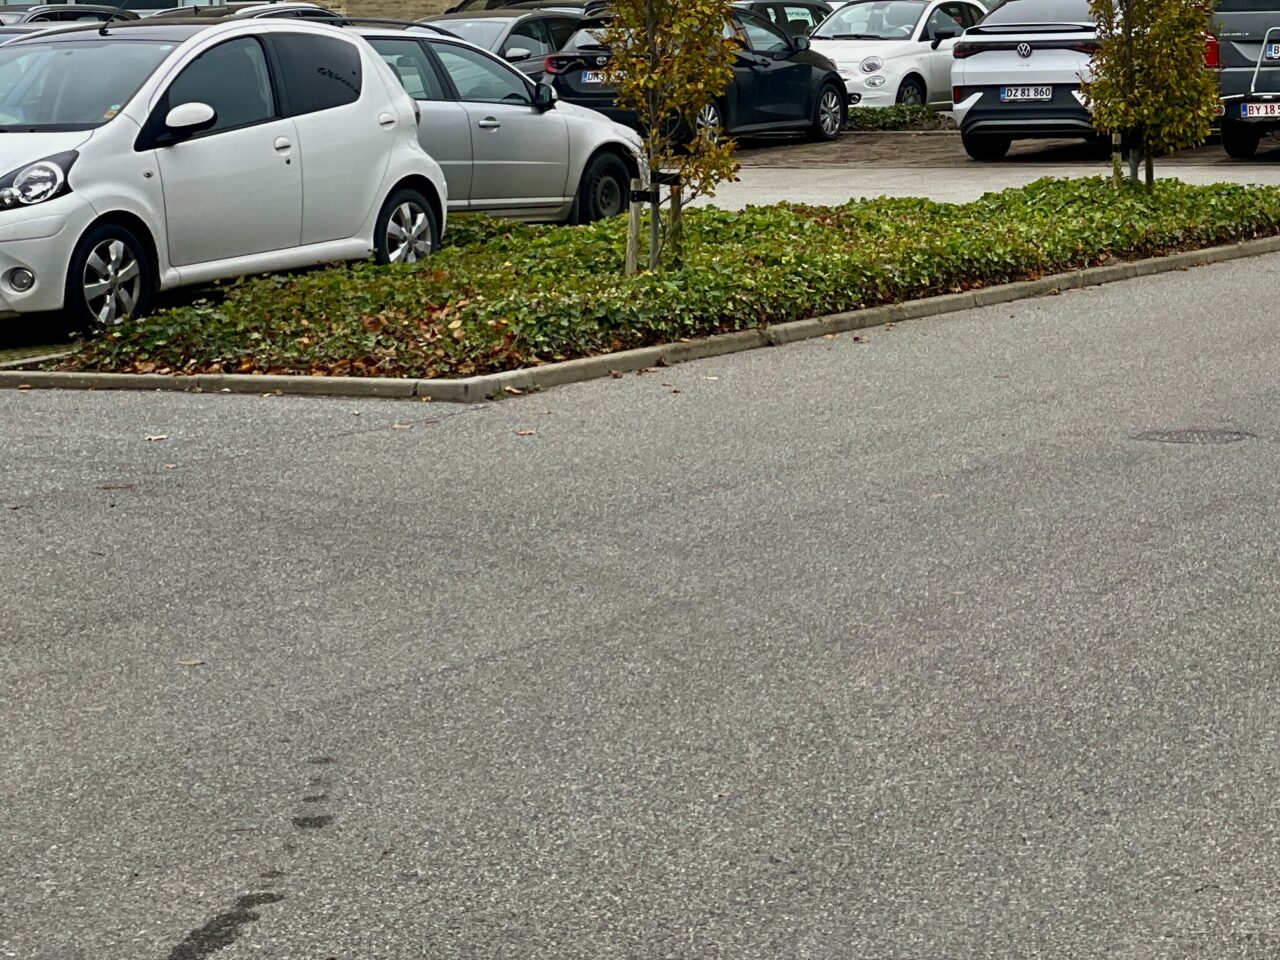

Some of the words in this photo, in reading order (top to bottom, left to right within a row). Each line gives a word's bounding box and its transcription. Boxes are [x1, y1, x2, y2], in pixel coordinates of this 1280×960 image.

[1006, 88, 1019, 98] DZ
[1020, 87, 1031, 98] 81
[1033, 87, 1051, 97] 860
[1248, 105, 1261, 115] BY
[1264, 104, 1275, 115] 18
